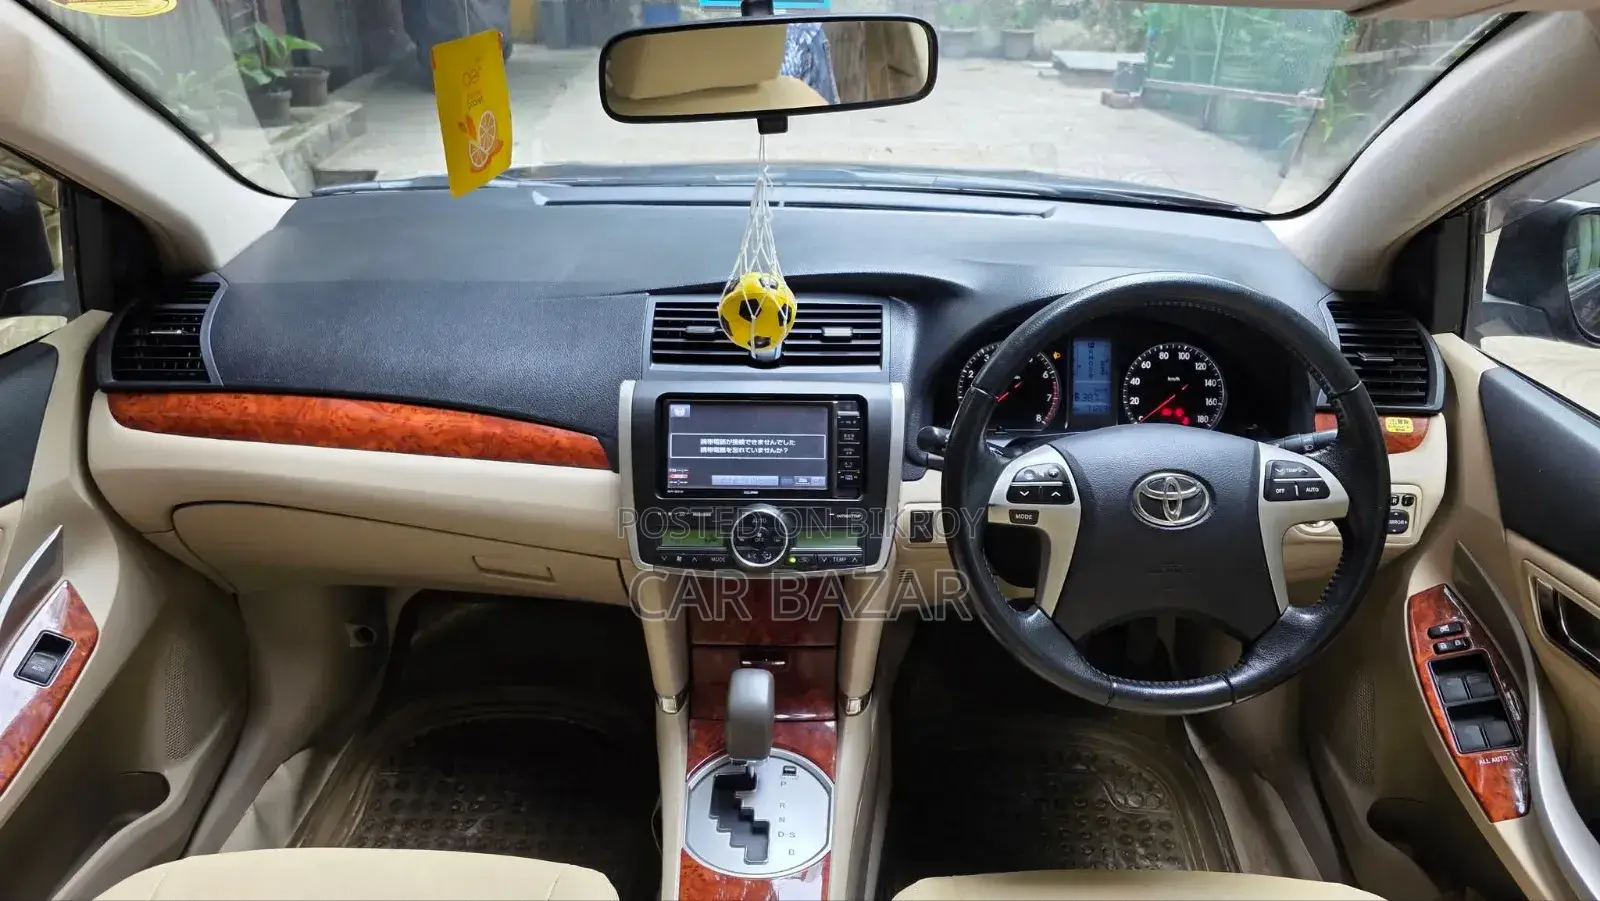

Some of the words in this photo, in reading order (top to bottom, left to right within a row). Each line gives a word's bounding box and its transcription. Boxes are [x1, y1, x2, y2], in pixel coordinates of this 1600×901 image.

[1142, 361, 1151, 369] 60
[1130, 397, 1139, 405] 20
[1206, 398, 1218, 406] 160
[1036, 414, 1042, 422] 8
[1197, 415, 1208, 423] 180
